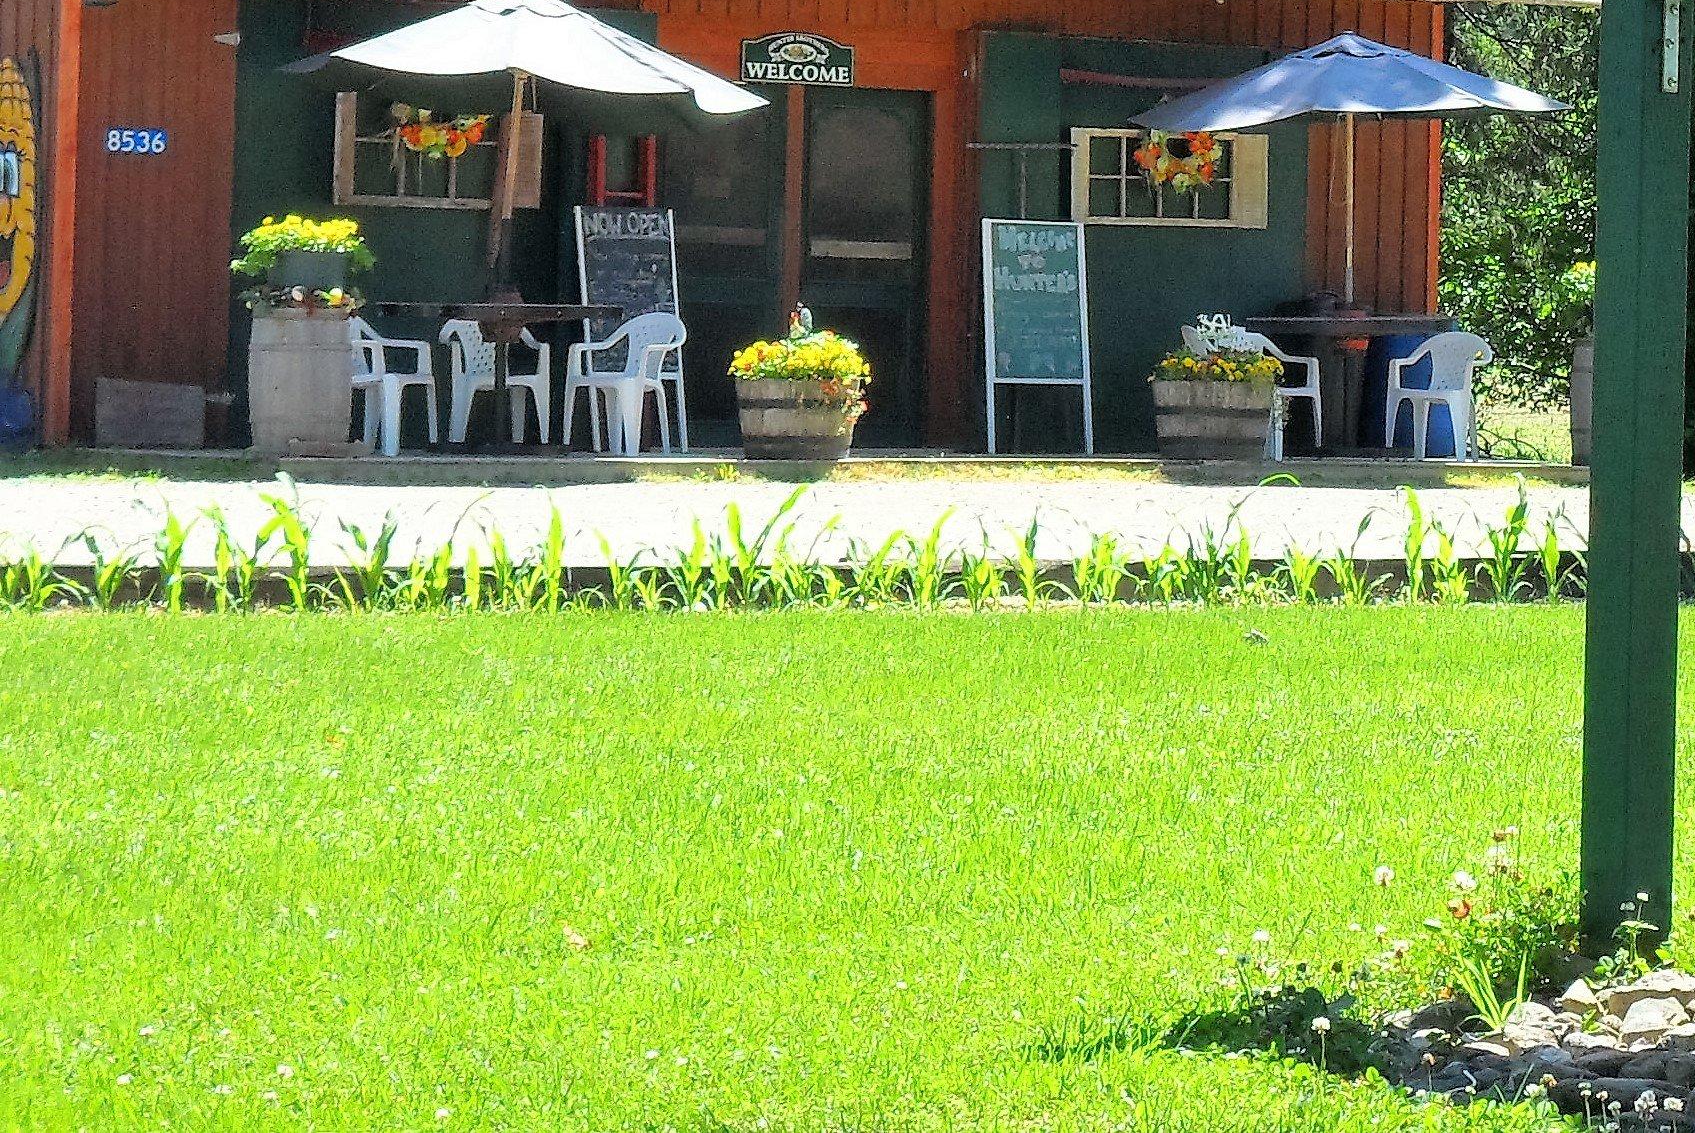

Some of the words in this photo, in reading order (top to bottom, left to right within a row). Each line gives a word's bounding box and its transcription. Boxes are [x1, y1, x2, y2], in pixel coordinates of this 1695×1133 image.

[746, 61, 850, 83] WELCOME
[107, 130, 166, 153] 8536
[583, 212, 623, 236] NOW
[627, 211, 671, 239] OPEN
